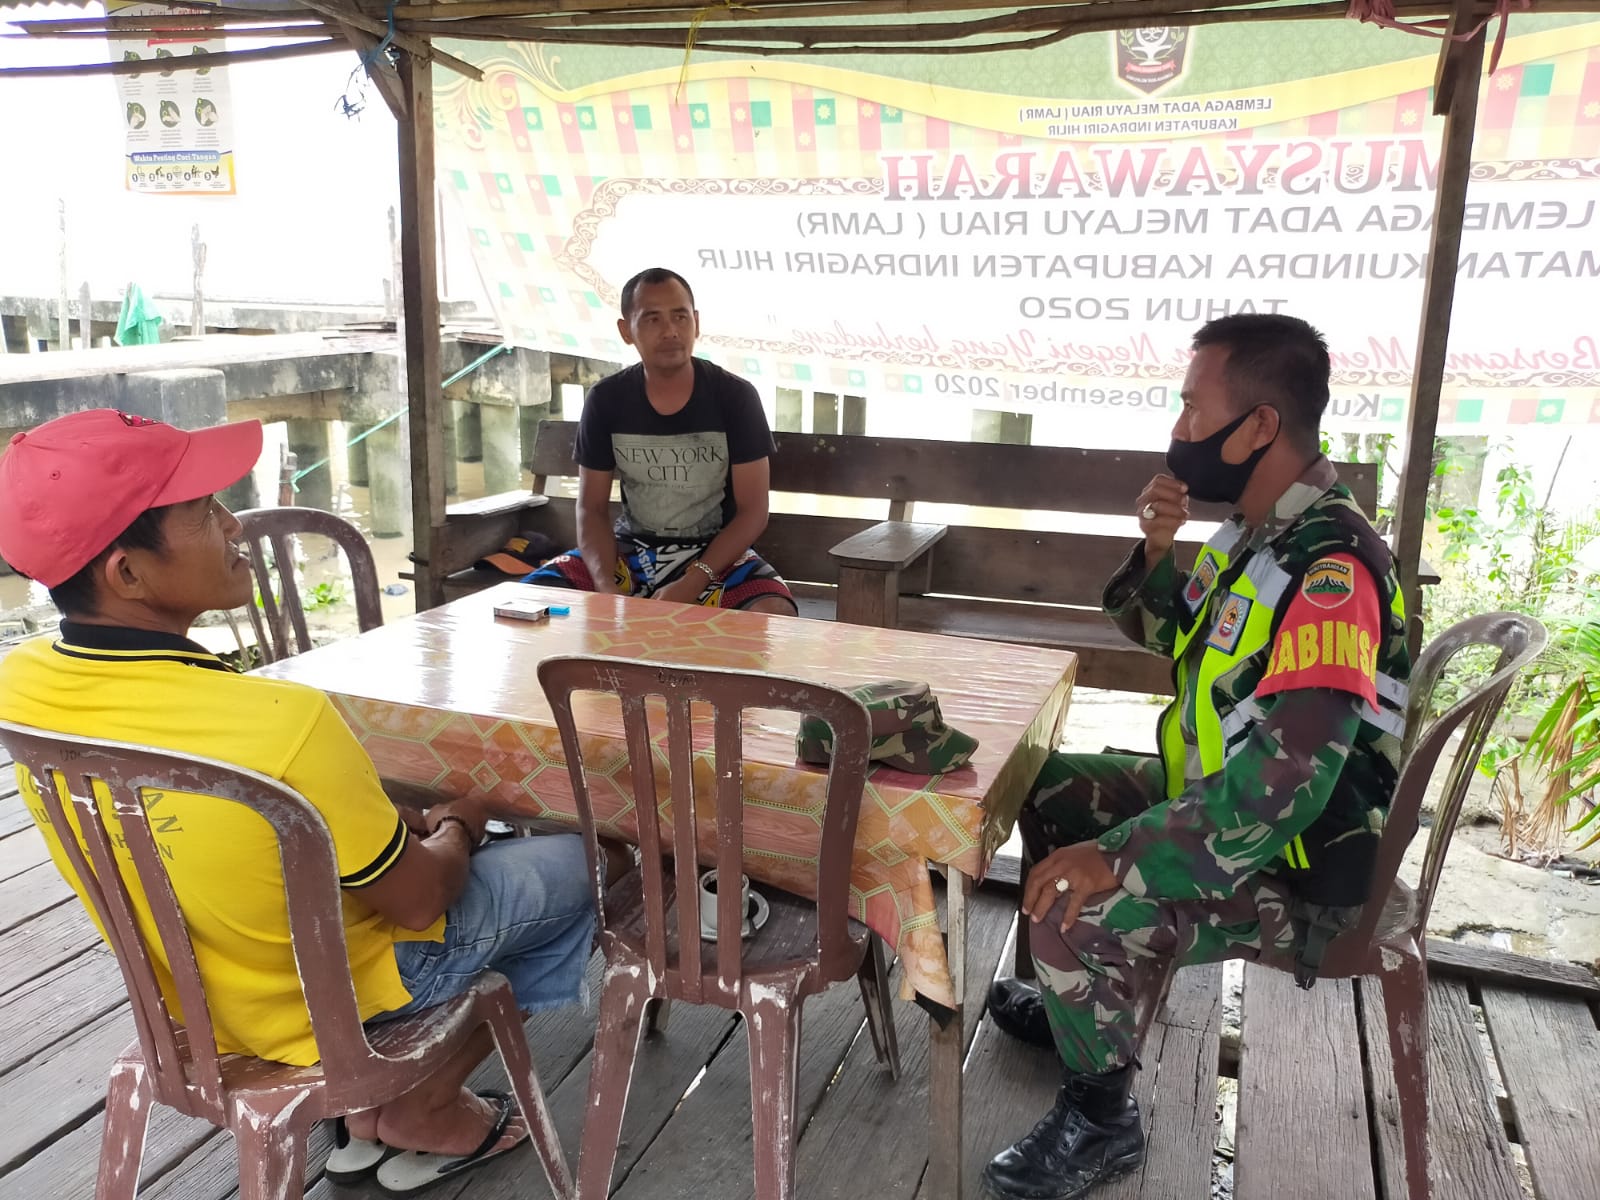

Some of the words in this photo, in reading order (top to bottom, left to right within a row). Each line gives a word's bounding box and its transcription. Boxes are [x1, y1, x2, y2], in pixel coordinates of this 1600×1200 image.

[615, 447, 663, 464] NEW
[671, 446, 724, 464] YORK
[647, 465, 694, 482] CITY
